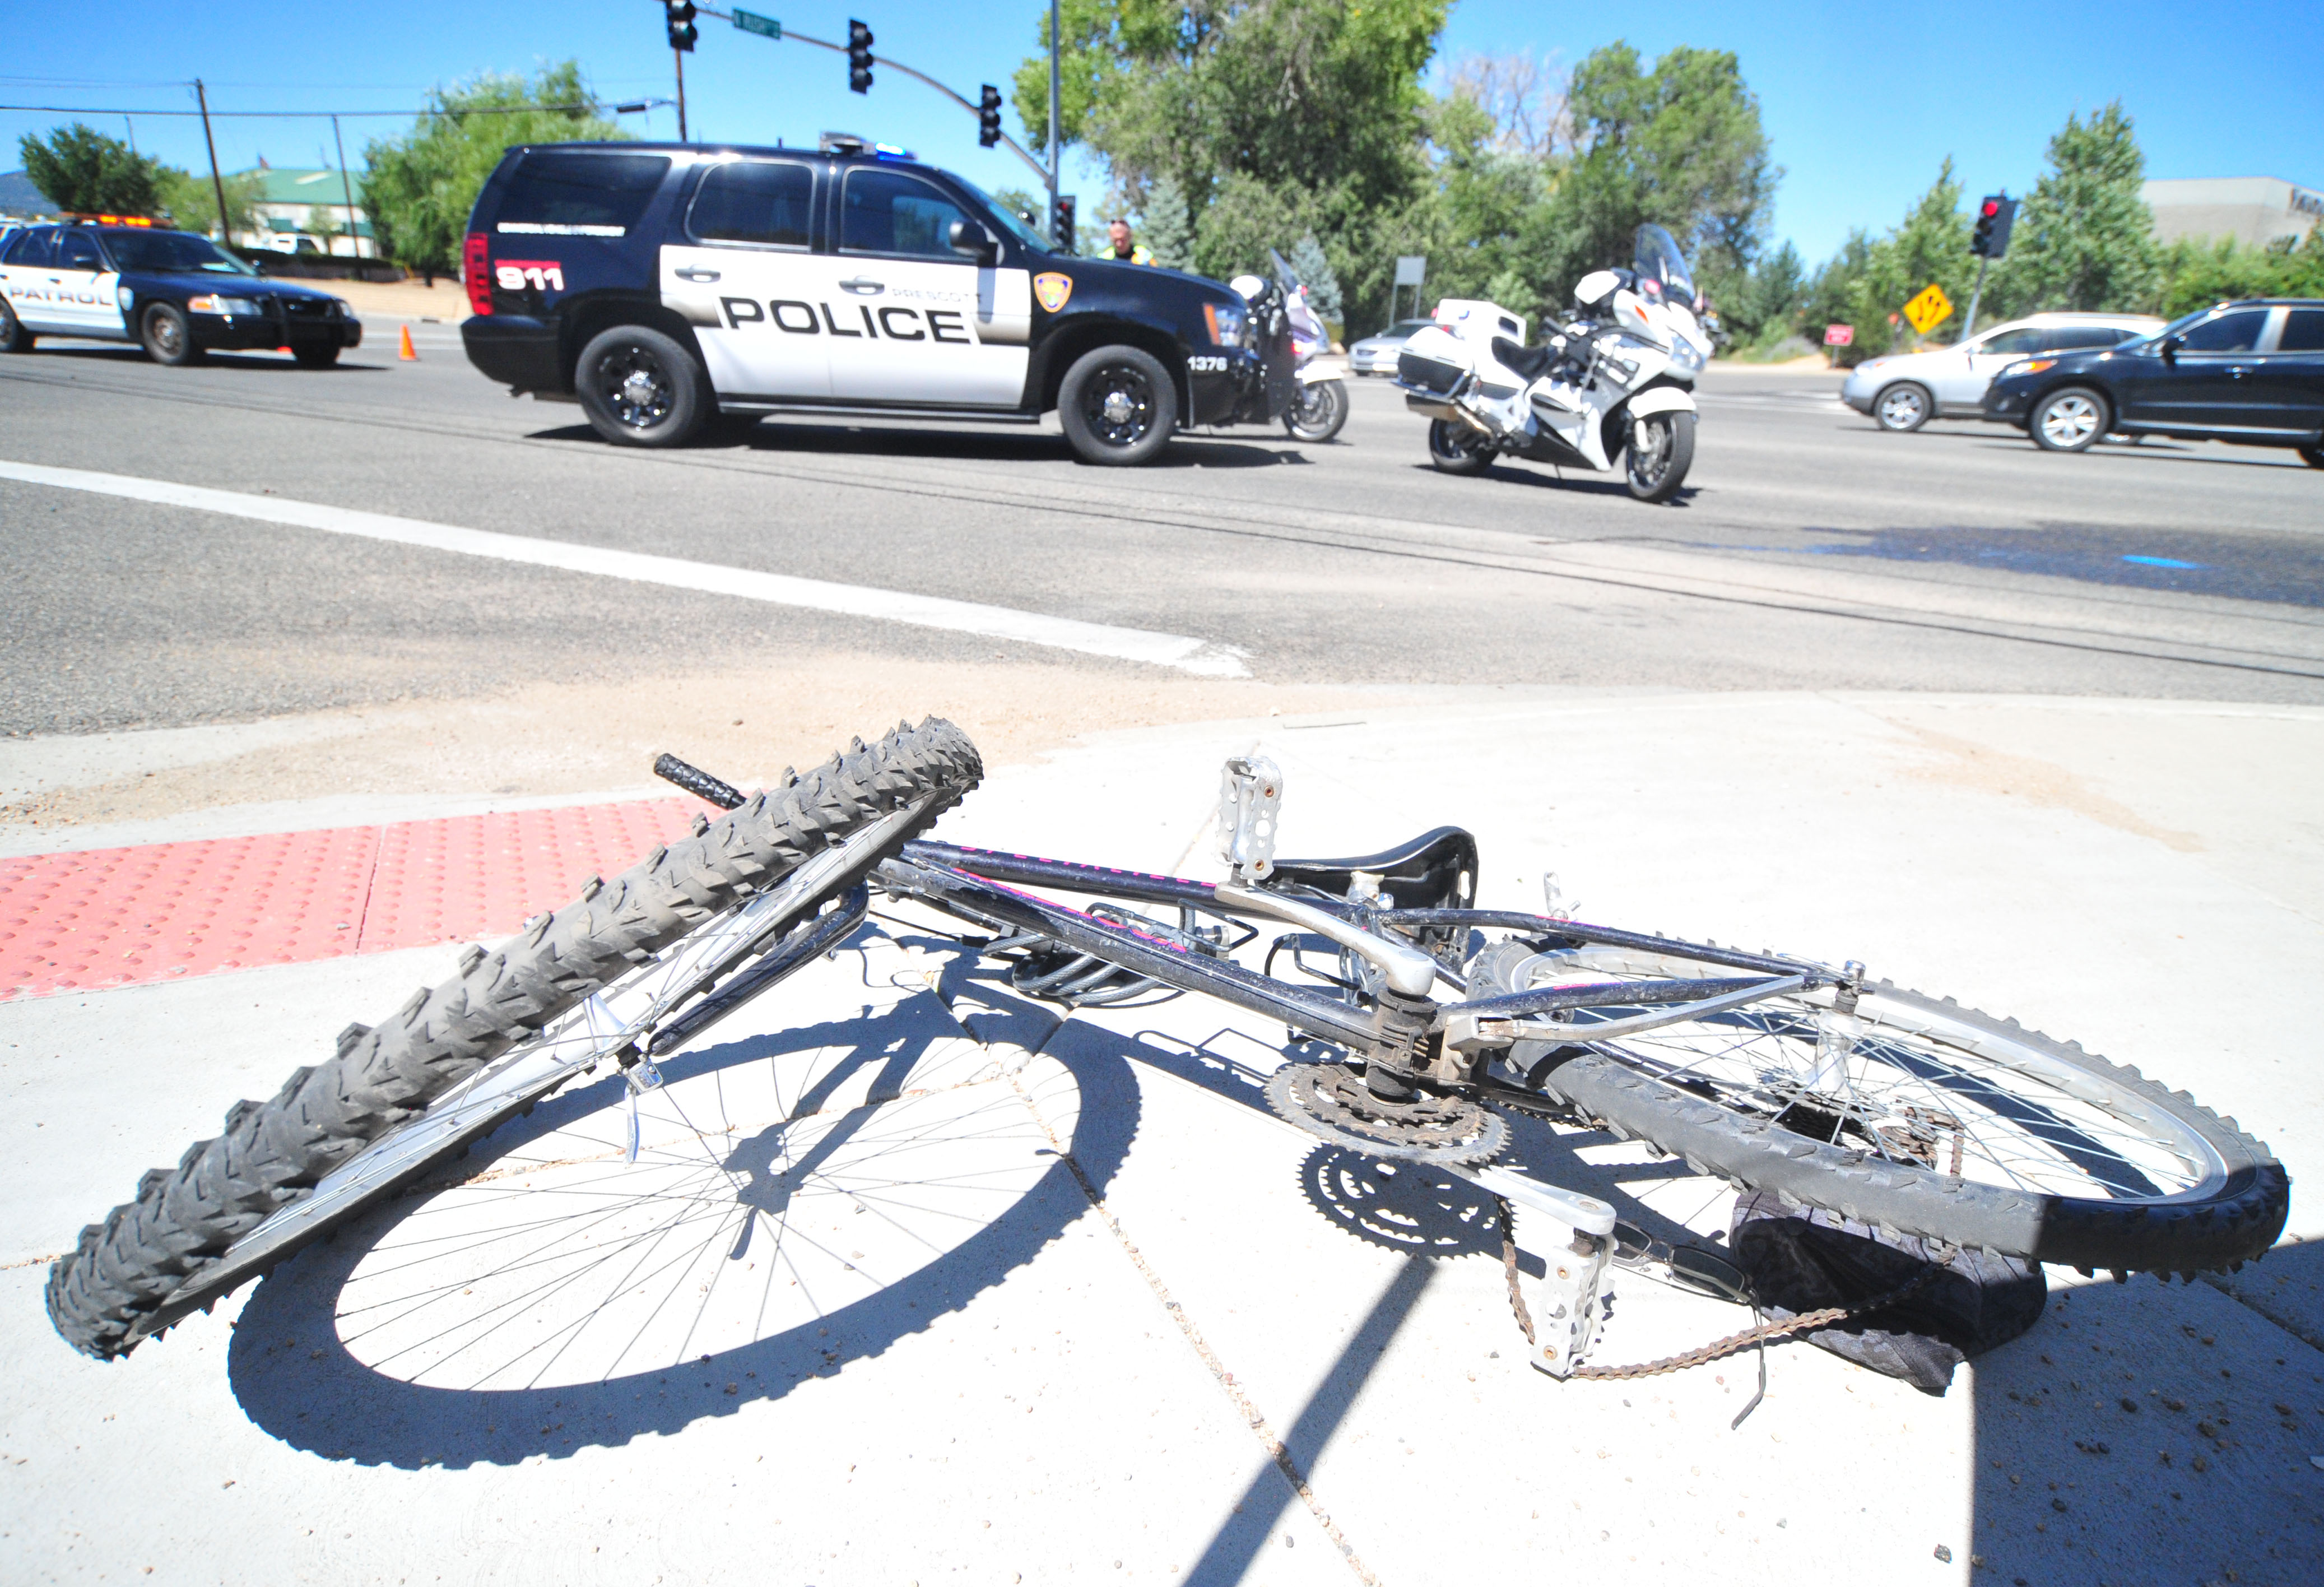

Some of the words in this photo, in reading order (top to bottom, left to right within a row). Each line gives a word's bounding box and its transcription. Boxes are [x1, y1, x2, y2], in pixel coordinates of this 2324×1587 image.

[496, 266, 564, 291] 911
[10, 287, 113, 306] PATROL
[720, 296, 970, 344] POLICE
